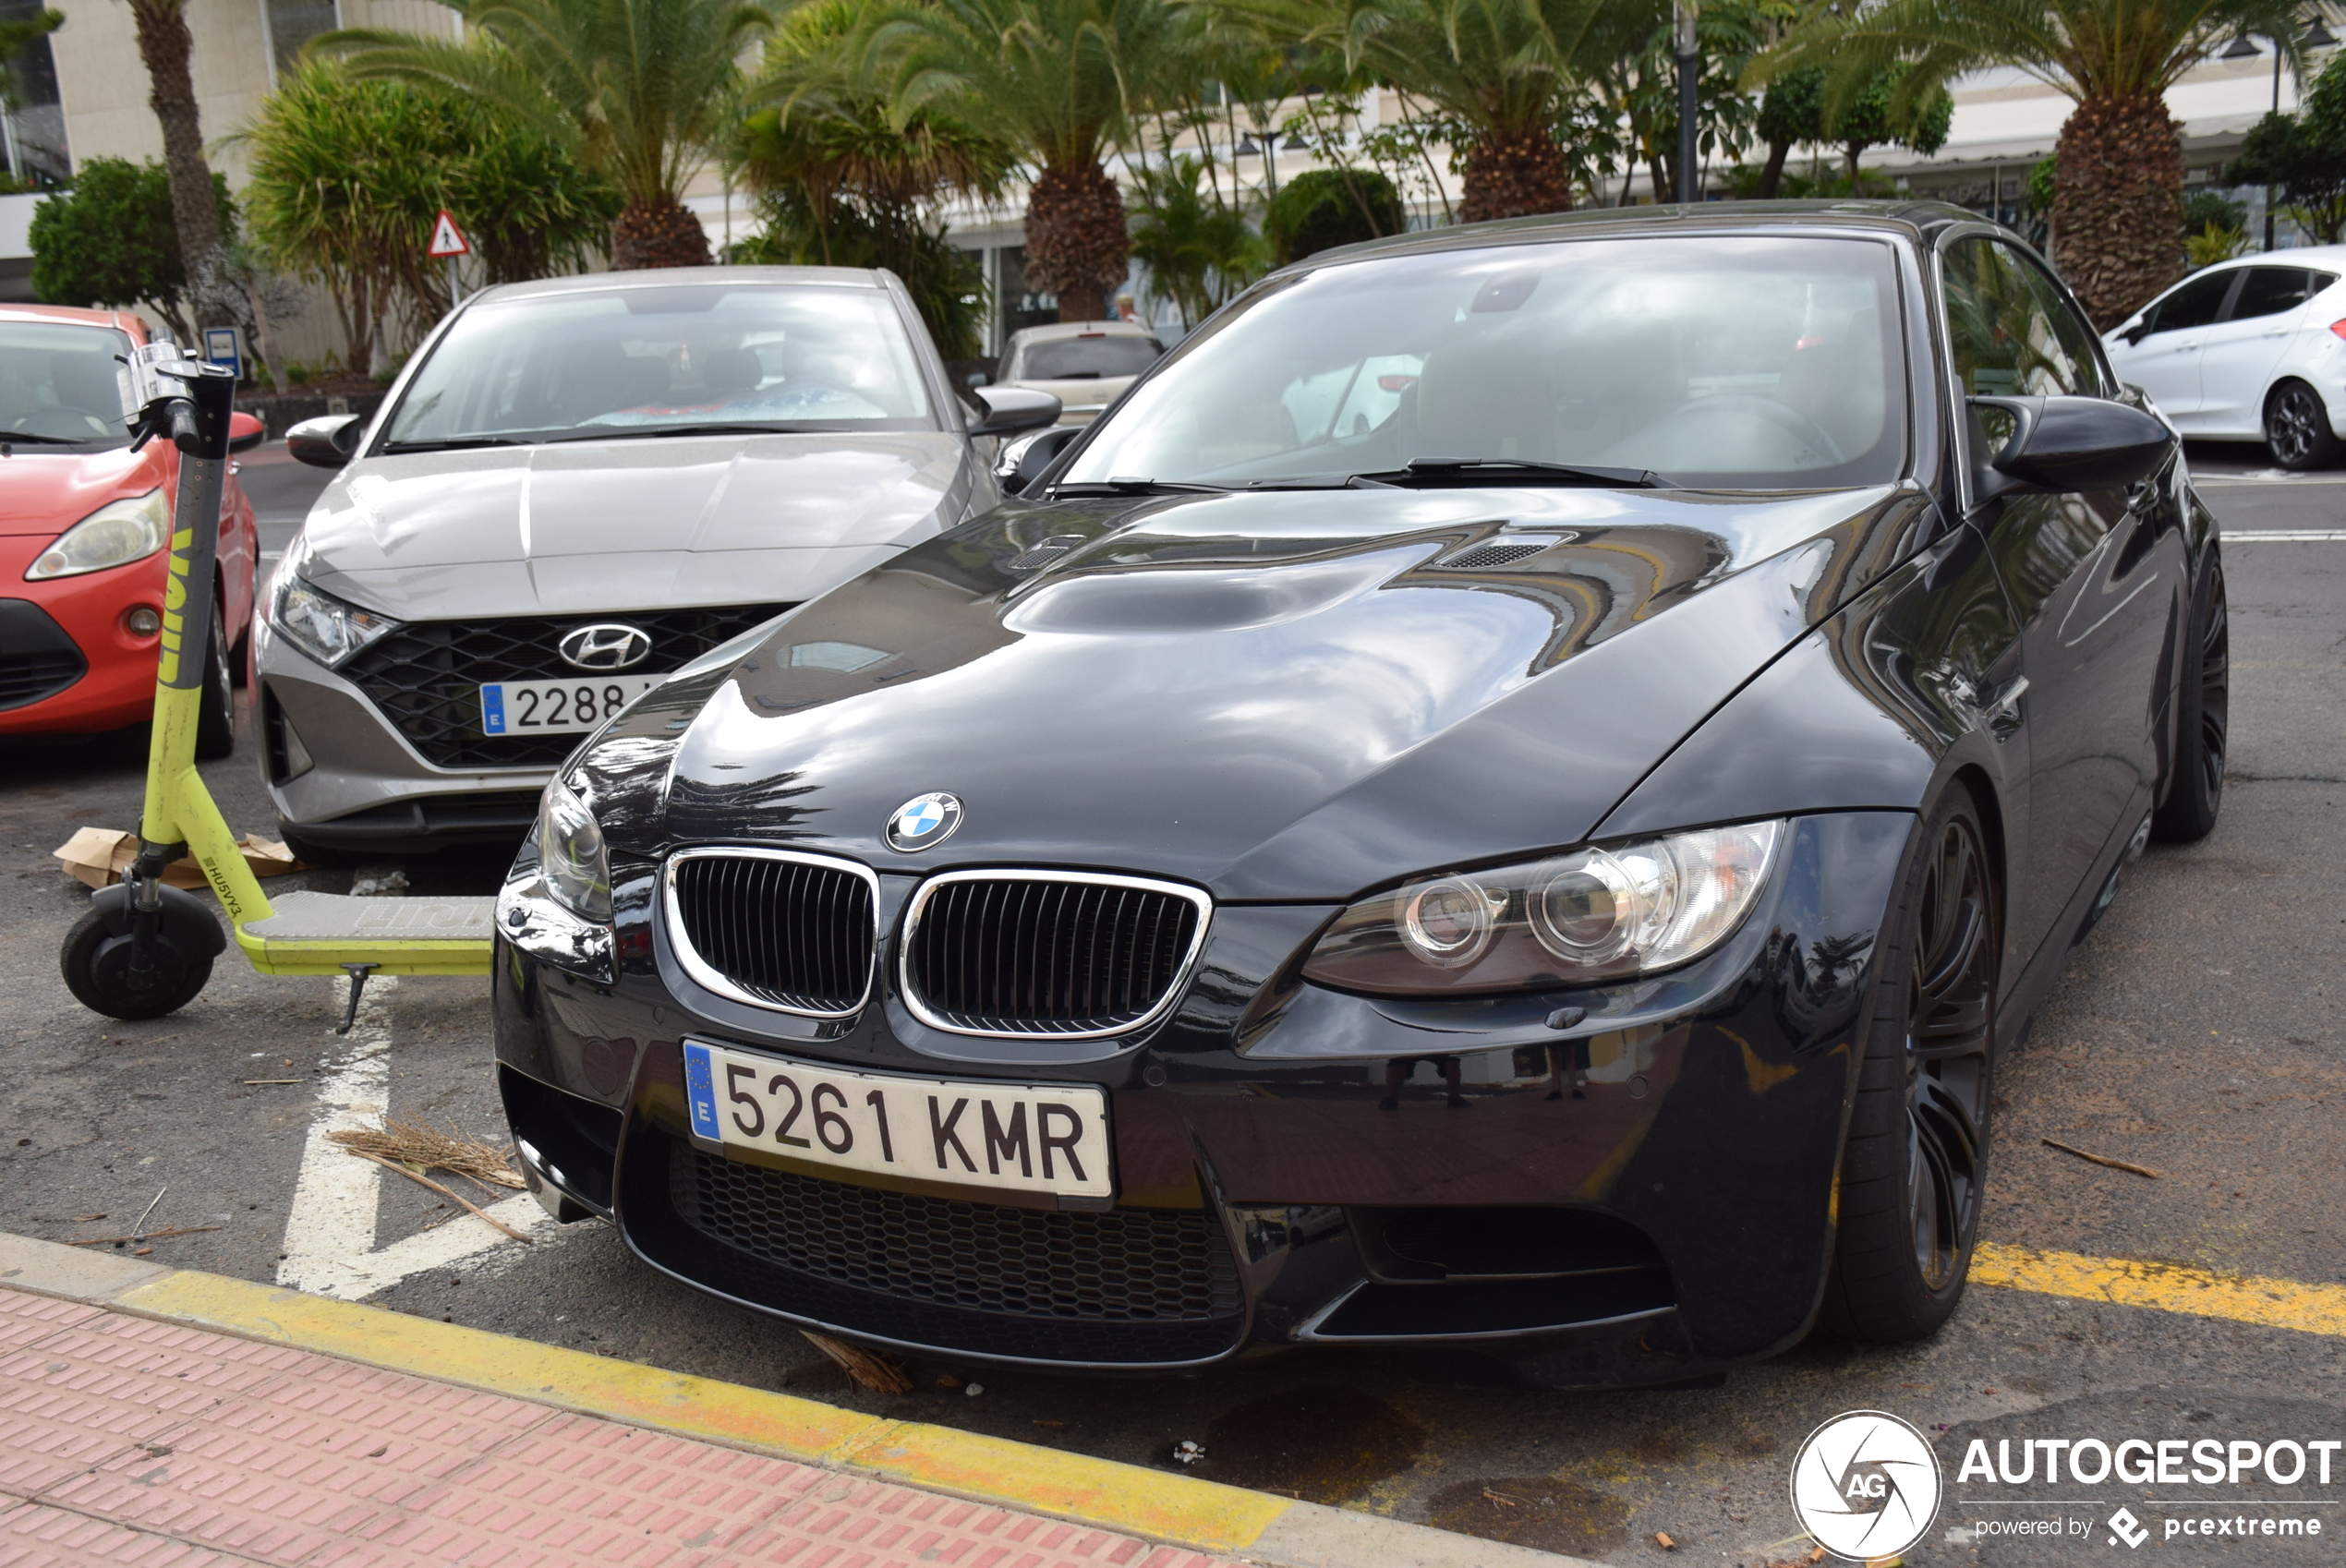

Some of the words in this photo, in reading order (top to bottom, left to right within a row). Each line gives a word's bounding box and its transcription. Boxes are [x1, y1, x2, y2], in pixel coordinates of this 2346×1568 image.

[490, 714, 500, 726] E
[516, 684, 624, 726] 2288
[209, 867, 242, 915] HU5VY3
[698, 1101, 710, 1122] E
[726, 1063, 894, 1163] 5261
[928, 1095, 1088, 1182] KMR
